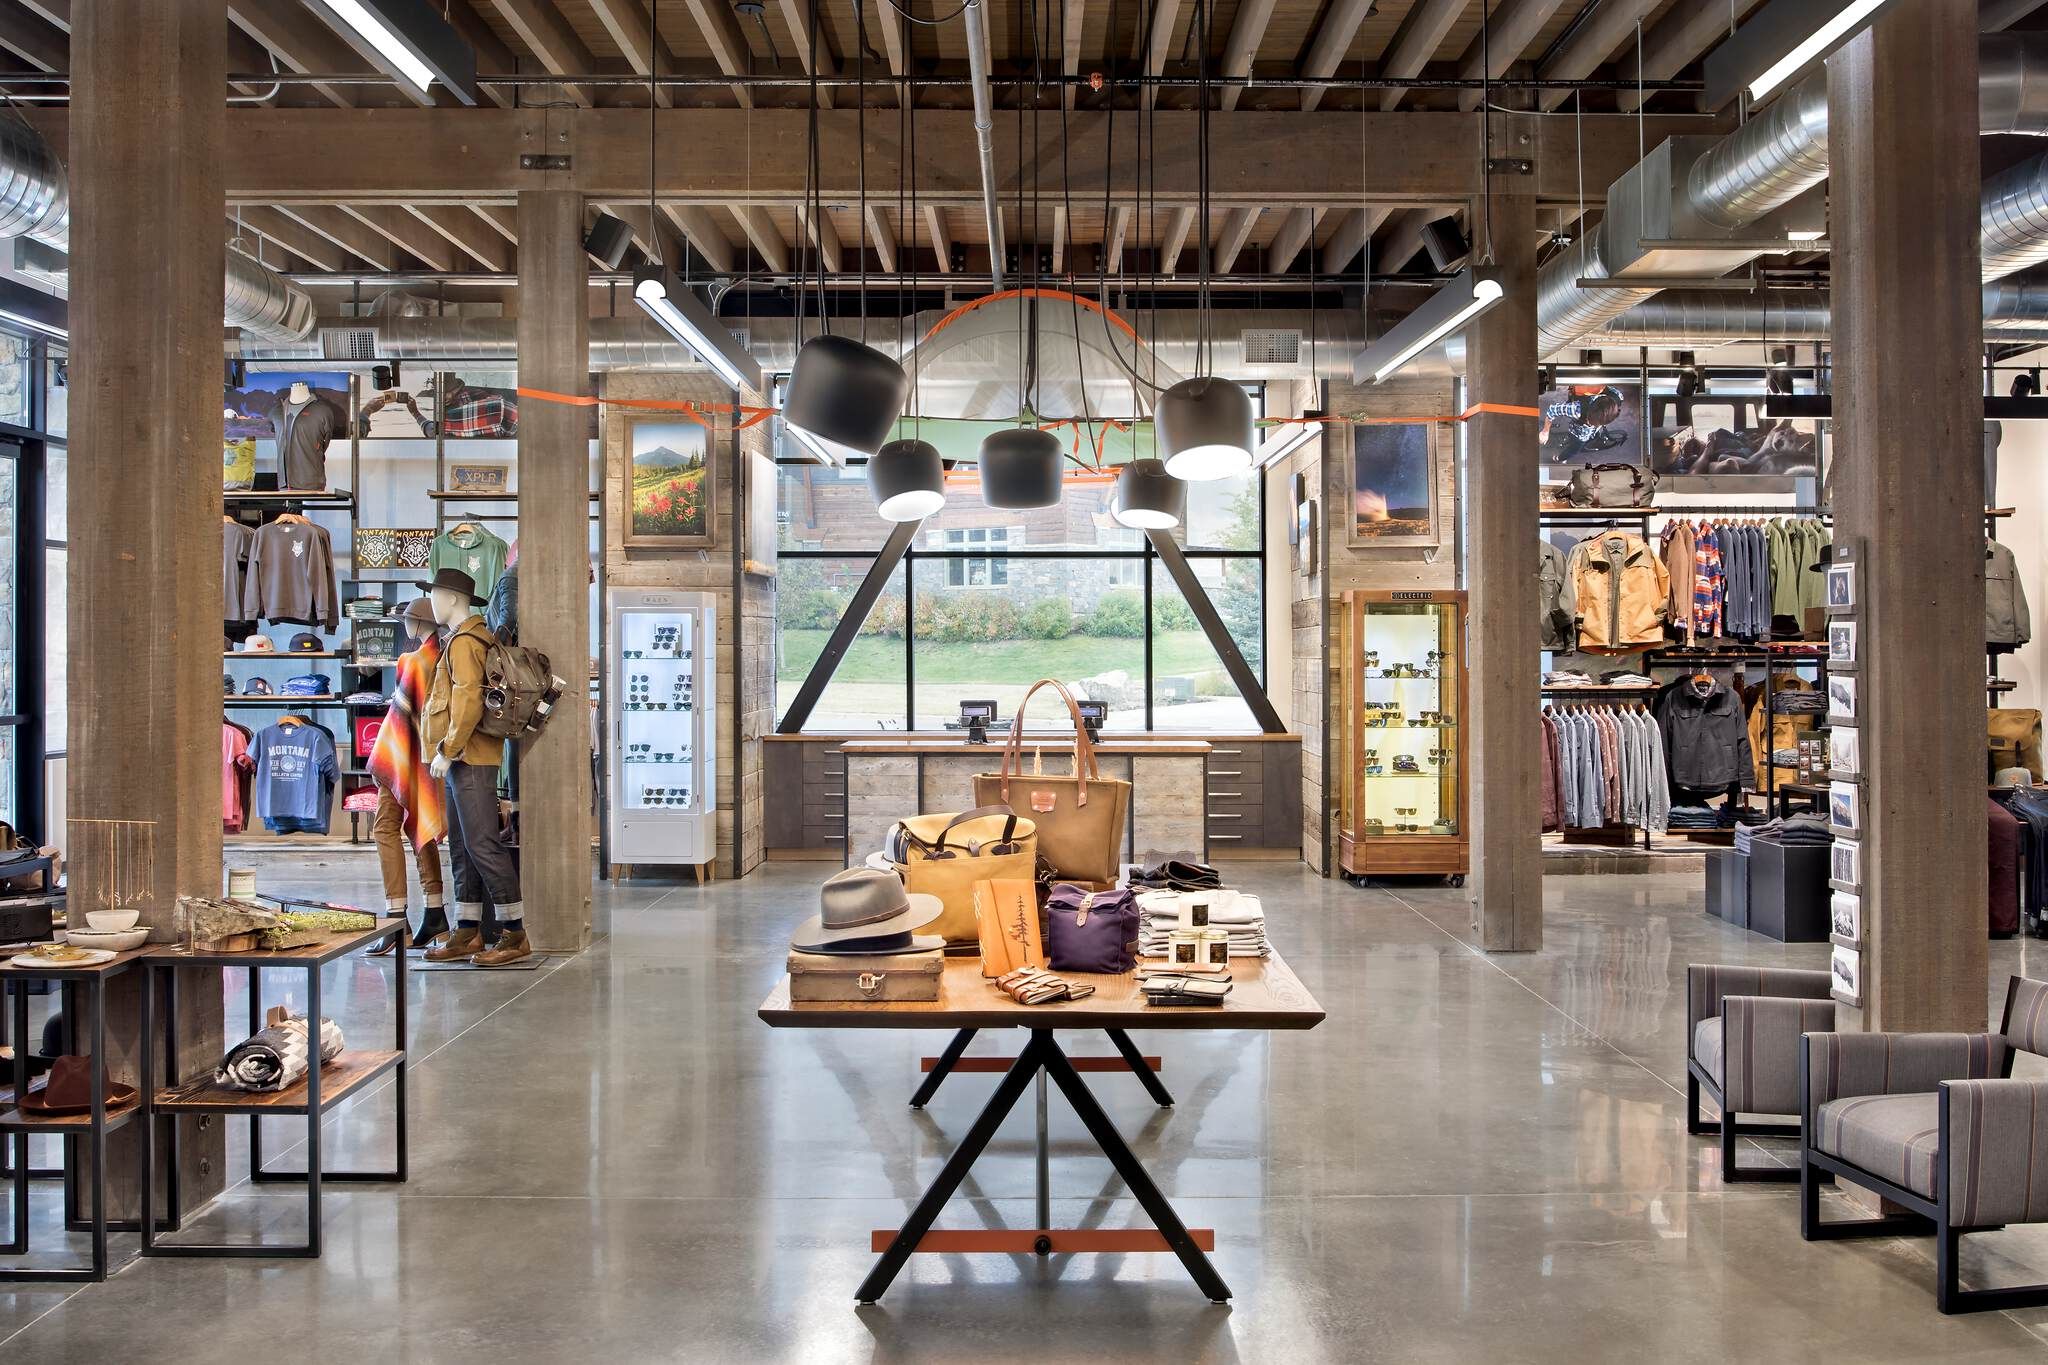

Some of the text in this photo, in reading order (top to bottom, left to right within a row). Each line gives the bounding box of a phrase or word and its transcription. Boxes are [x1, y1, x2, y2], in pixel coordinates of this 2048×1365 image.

[464, 472, 497, 483] XPLR
[396, 530, 434, 538] MONTANA
[268, 745, 310, 758] MONTANA
